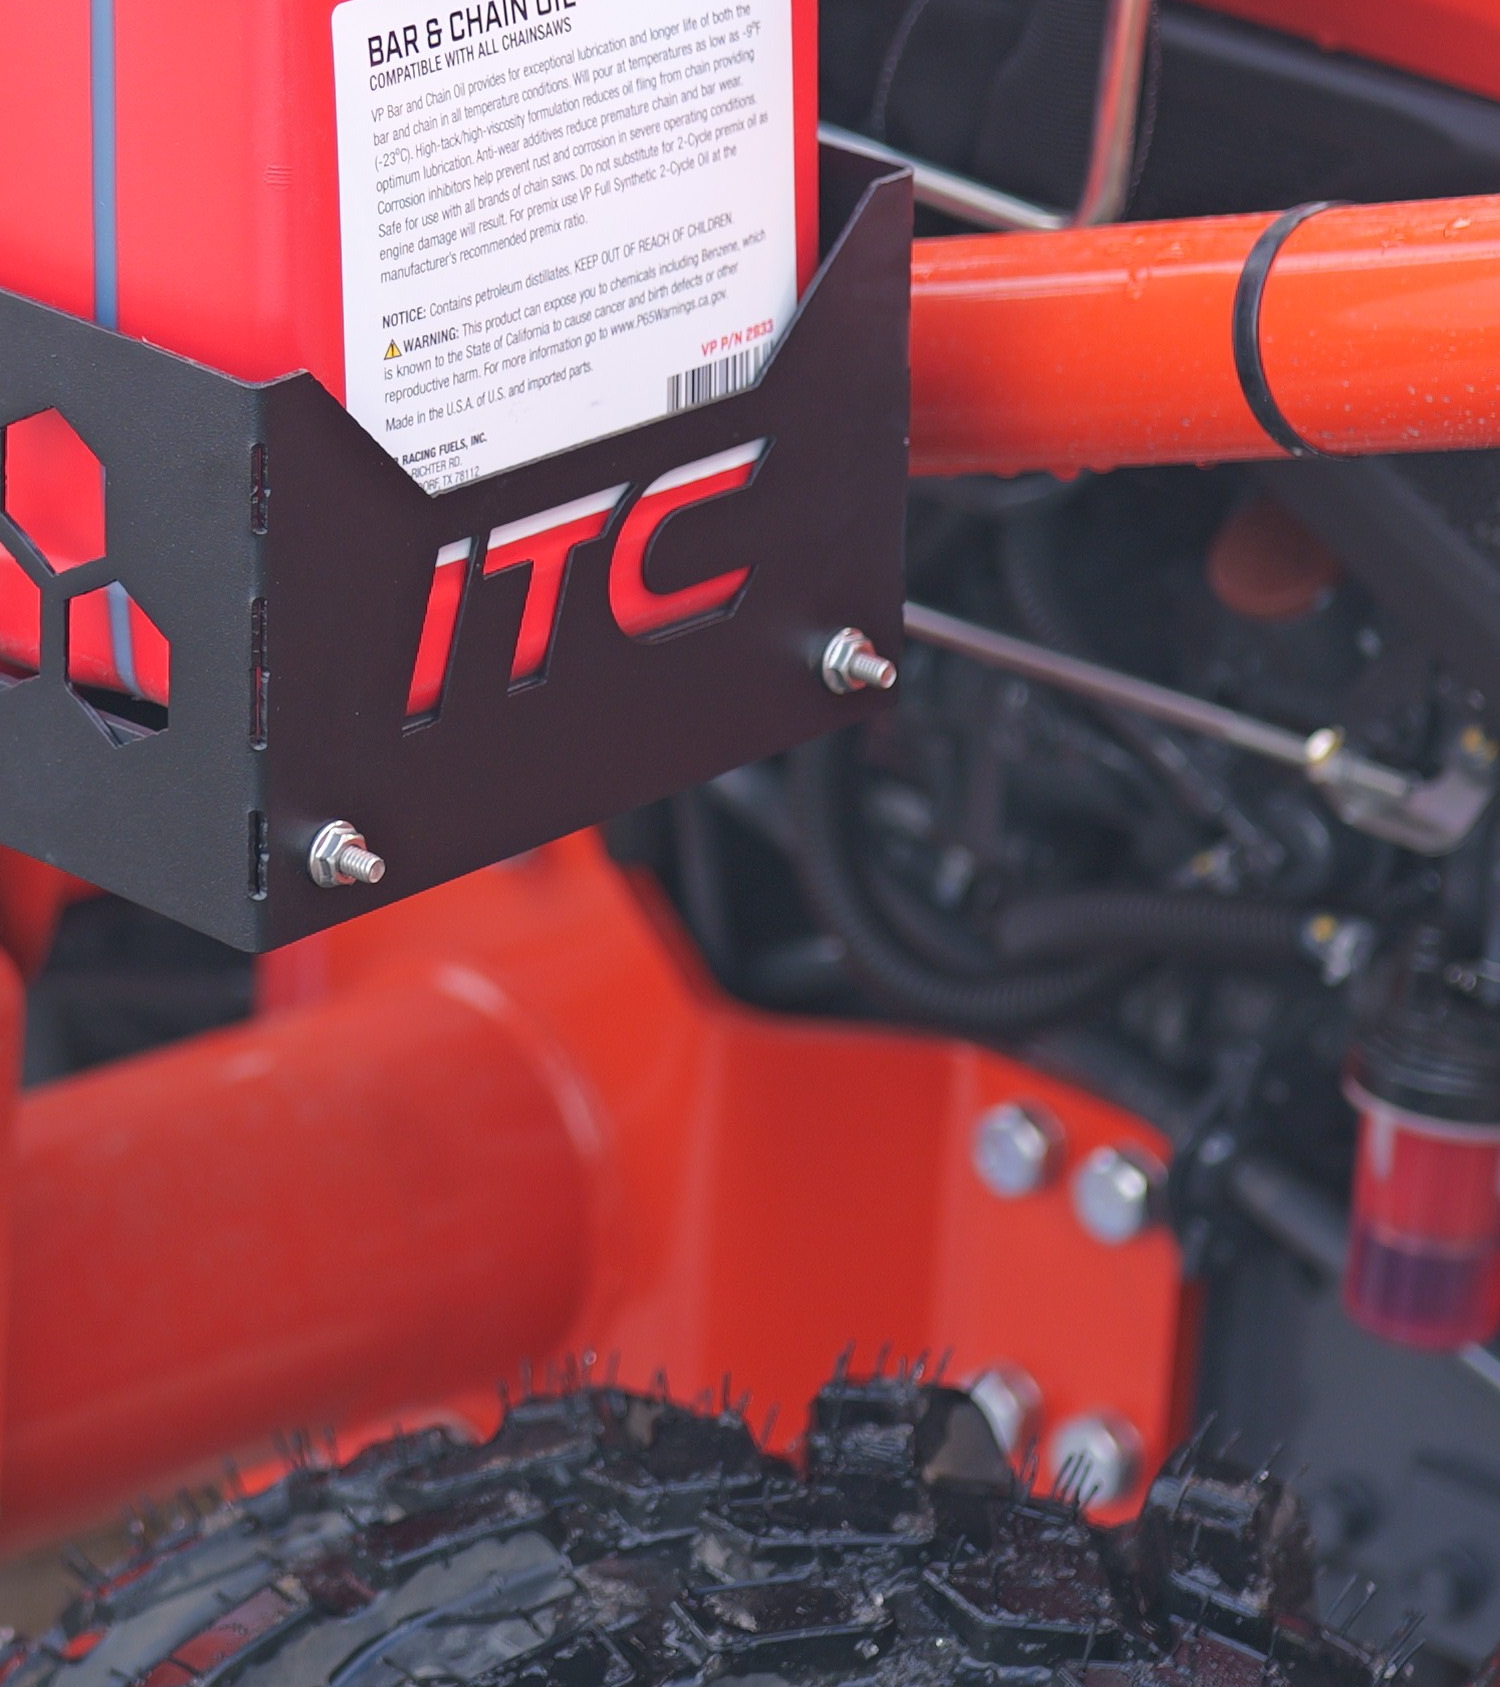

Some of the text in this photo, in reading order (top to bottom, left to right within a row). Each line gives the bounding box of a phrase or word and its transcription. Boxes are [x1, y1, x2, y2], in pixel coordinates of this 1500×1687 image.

[368, 24, 419, 68] BAR
[426, 18, 442, 49] &
[369, 16, 572, 91] COMPATIBLE WITH ALL CHAINSAWS
[371, 23, 680, 123] VP Bar and Chain Oil provides for exceptional lubrication and longer
[373, 59, 627, 147] bar and chain in all temperature conditions. Will pour at
[376, 93, 678, 194] optimum lubrication. Anti-wear additives reduce premature chain
[415, 69, 682, 158] High-tack/high-viscosity formulation reduces oil fling from
[377, 122, 661, 215] Corrosion inhibitors help prevent rust and corrosion in severe
[378, 140, 674, 238] Safe for use with all brands of chain saws. Do not substitute for
[379, 169, 657, 261] engine damage will result. For premix use VP Full Synthetic
[380, 213, 588, 283] manufacturer's recommended premix ratio.
[382, 226, 684, 329] NOTICE: Contains petroleum distillates. KEEP OUT OF REACH OF
[403, 266, 656, 353] WARNING: This product can expose you to chemicals
[384, 285, 669, 381] is known to the State of California to cause cancer and birth
[384, 327, 608, 404] reproductive harm. For more information go to
[721, 331, 742, 350] P/N
[386, 361, 594, 432] Made in the U.S.A. of U.S. and imported parts.
[401, 447, 436, 465] RACING
[439, 438, 468, 456] FUELS,
[470, 432, 487, 446] INC.
[442, 465, 480, 486] TX 78112
[448, 455, 462, 469] RD.
[400, 434, 777, 739] ITC
